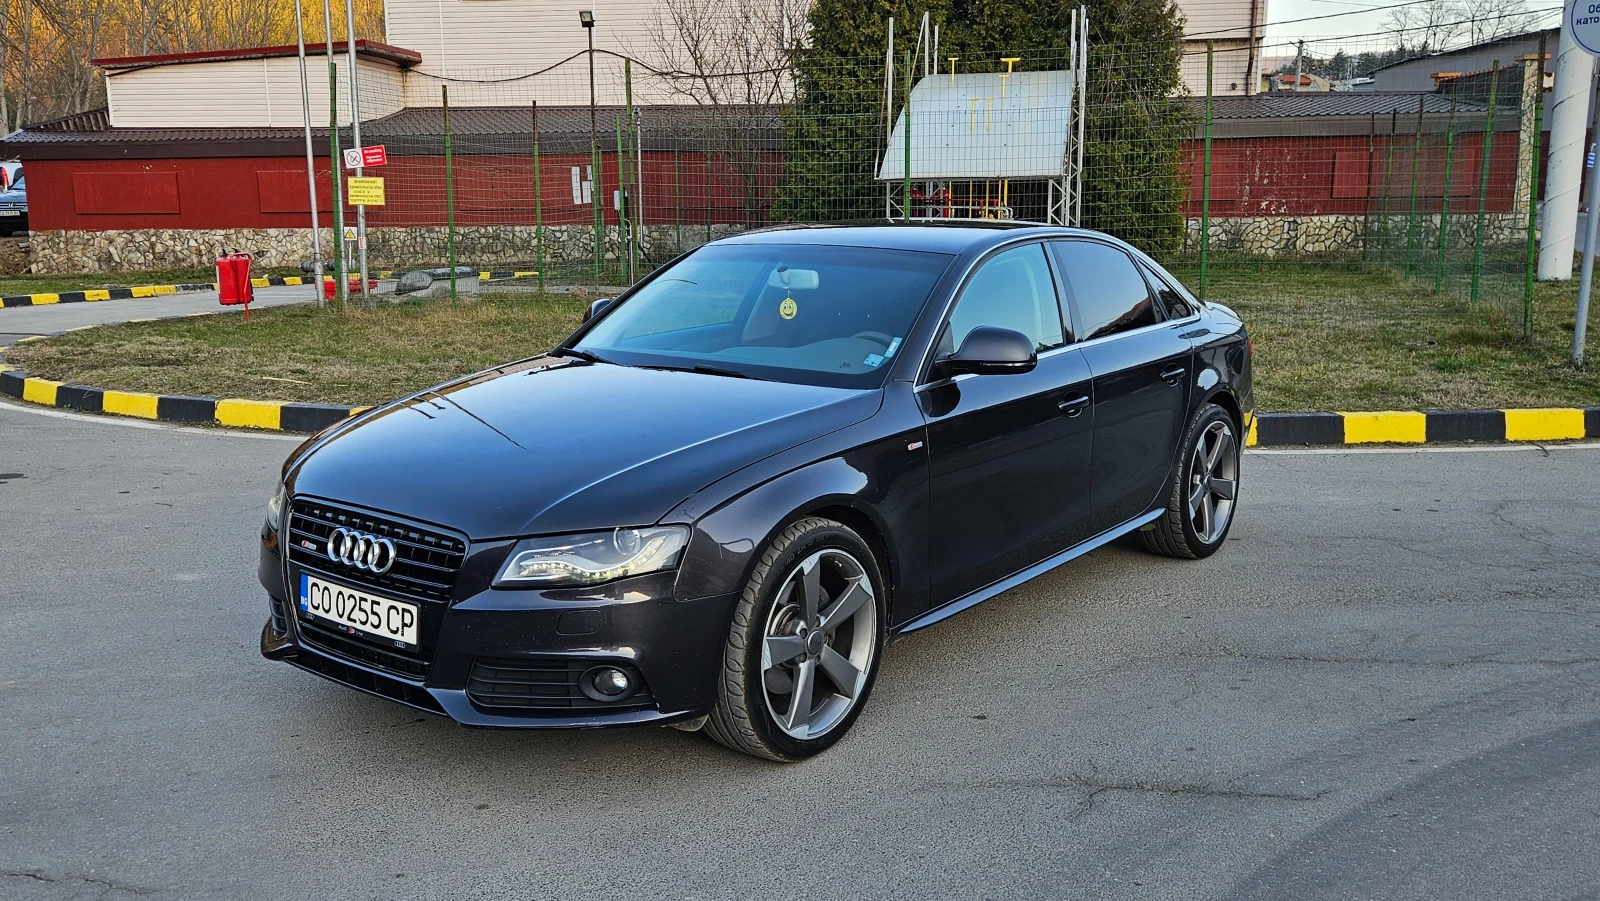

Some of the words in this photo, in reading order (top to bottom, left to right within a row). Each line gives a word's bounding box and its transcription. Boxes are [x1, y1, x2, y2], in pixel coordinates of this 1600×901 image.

[310, 582, 331, 614] CO
[336, 590, 381, 629] 0255
[386, 605, 414, 637] CP
